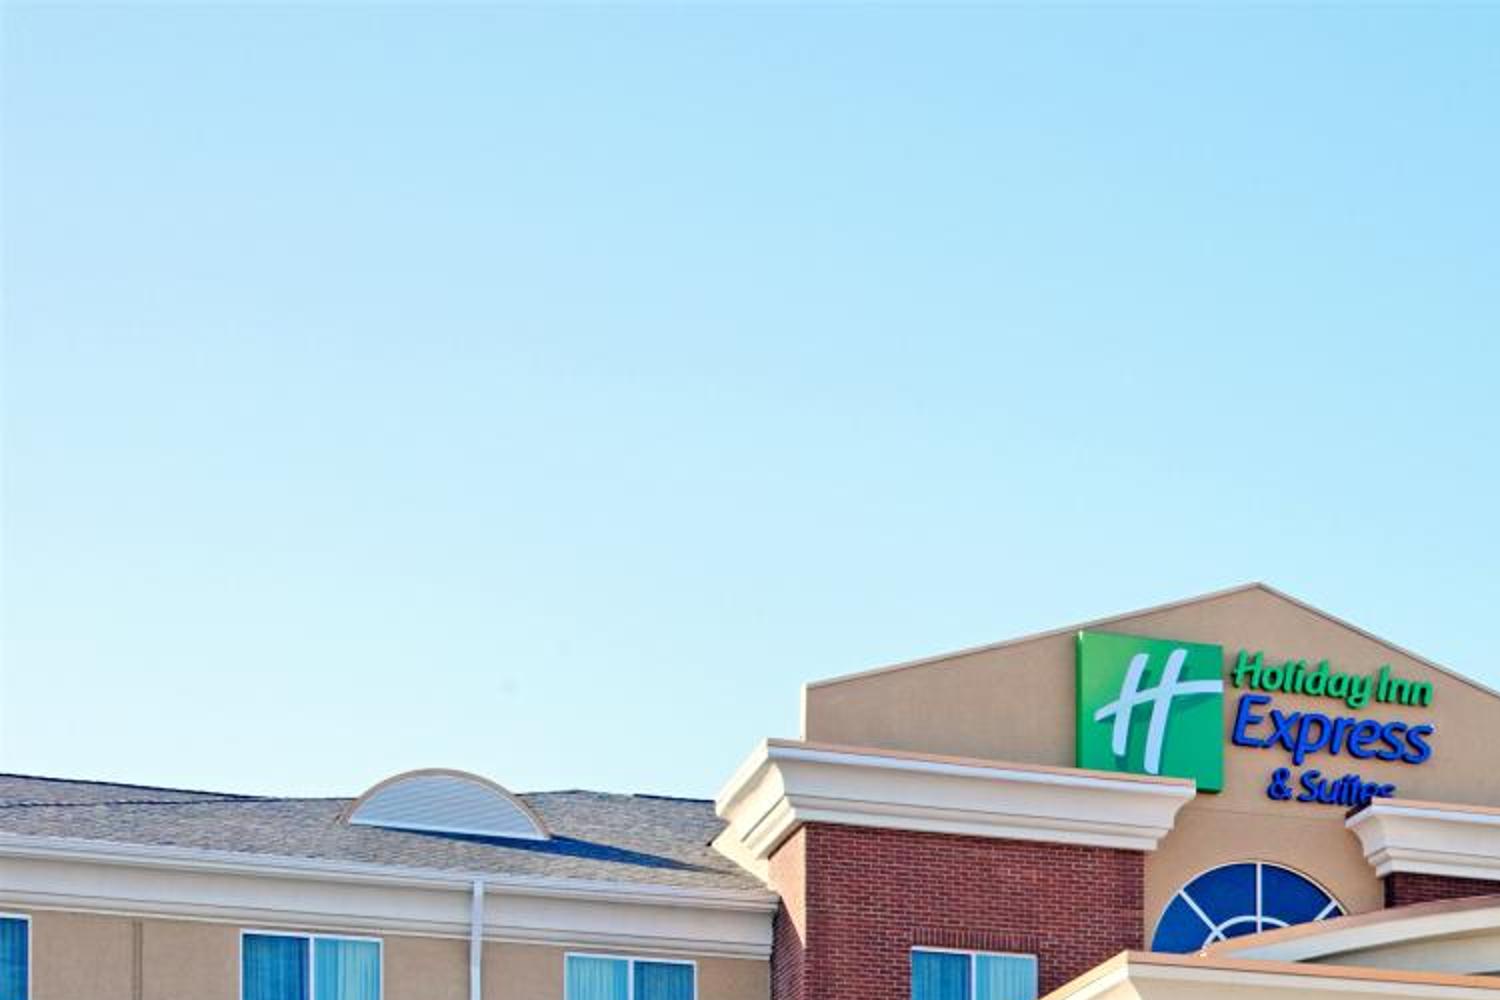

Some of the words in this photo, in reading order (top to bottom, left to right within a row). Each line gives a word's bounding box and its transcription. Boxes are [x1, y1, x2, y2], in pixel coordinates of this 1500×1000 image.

[1232, 650, 1375, 709] Holiday
[1376, 664, 1434, 706] Inn
[1232, 694, 1434, 766] Express
[1267, 767, 1292, 800] &
